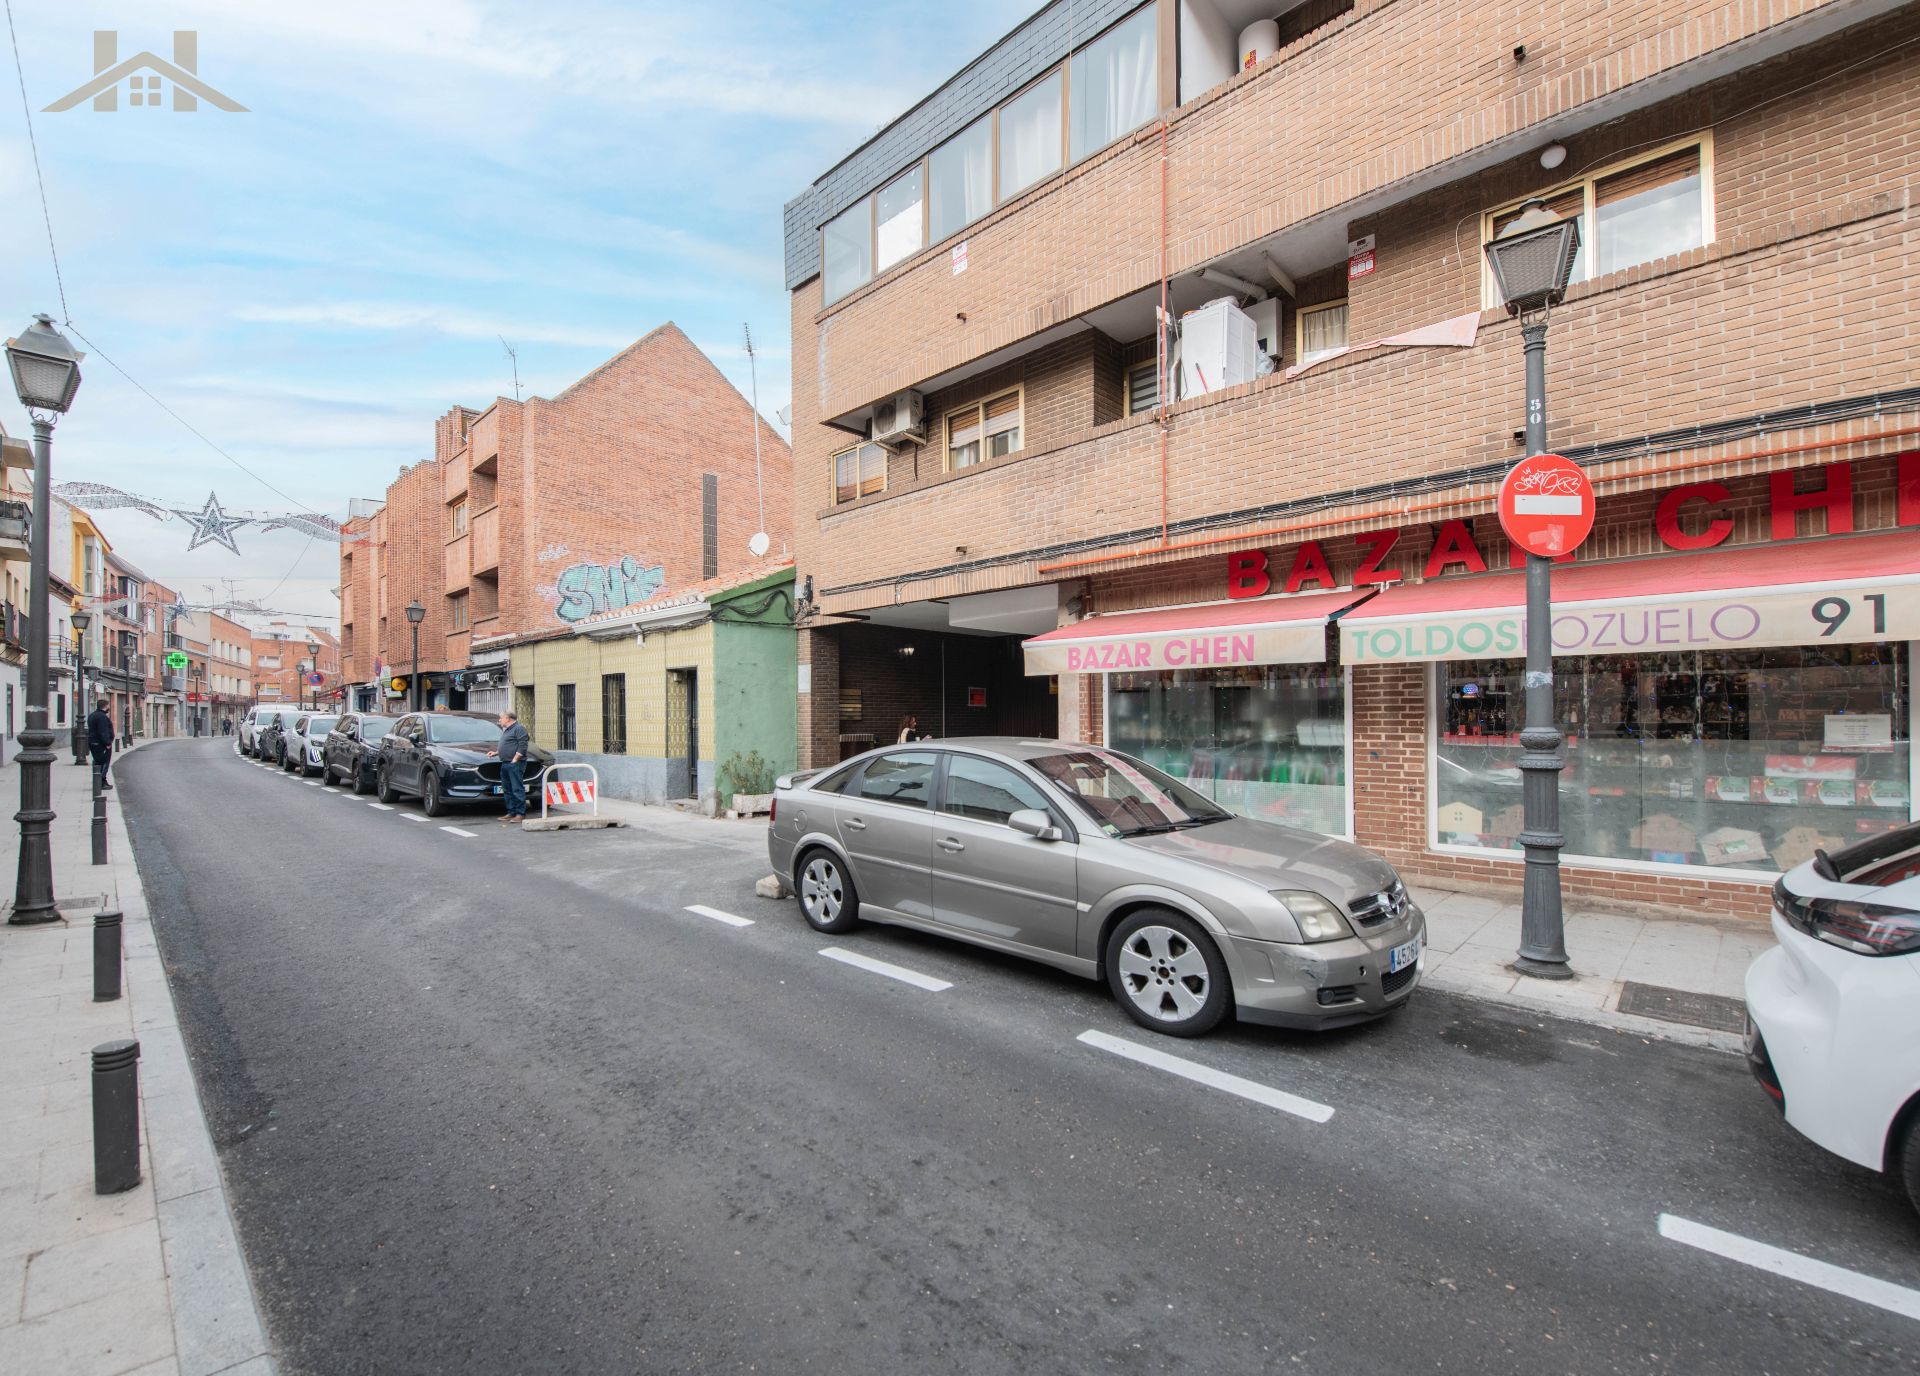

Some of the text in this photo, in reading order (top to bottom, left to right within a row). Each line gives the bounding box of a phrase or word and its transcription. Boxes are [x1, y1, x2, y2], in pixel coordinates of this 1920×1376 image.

[1228, 517, 1577, 599] BAZA
[1068, 634, 1255, 671] BAZAR CHEN
[1352, 593, 1886, 659] TOLDOS OZUELO 91
